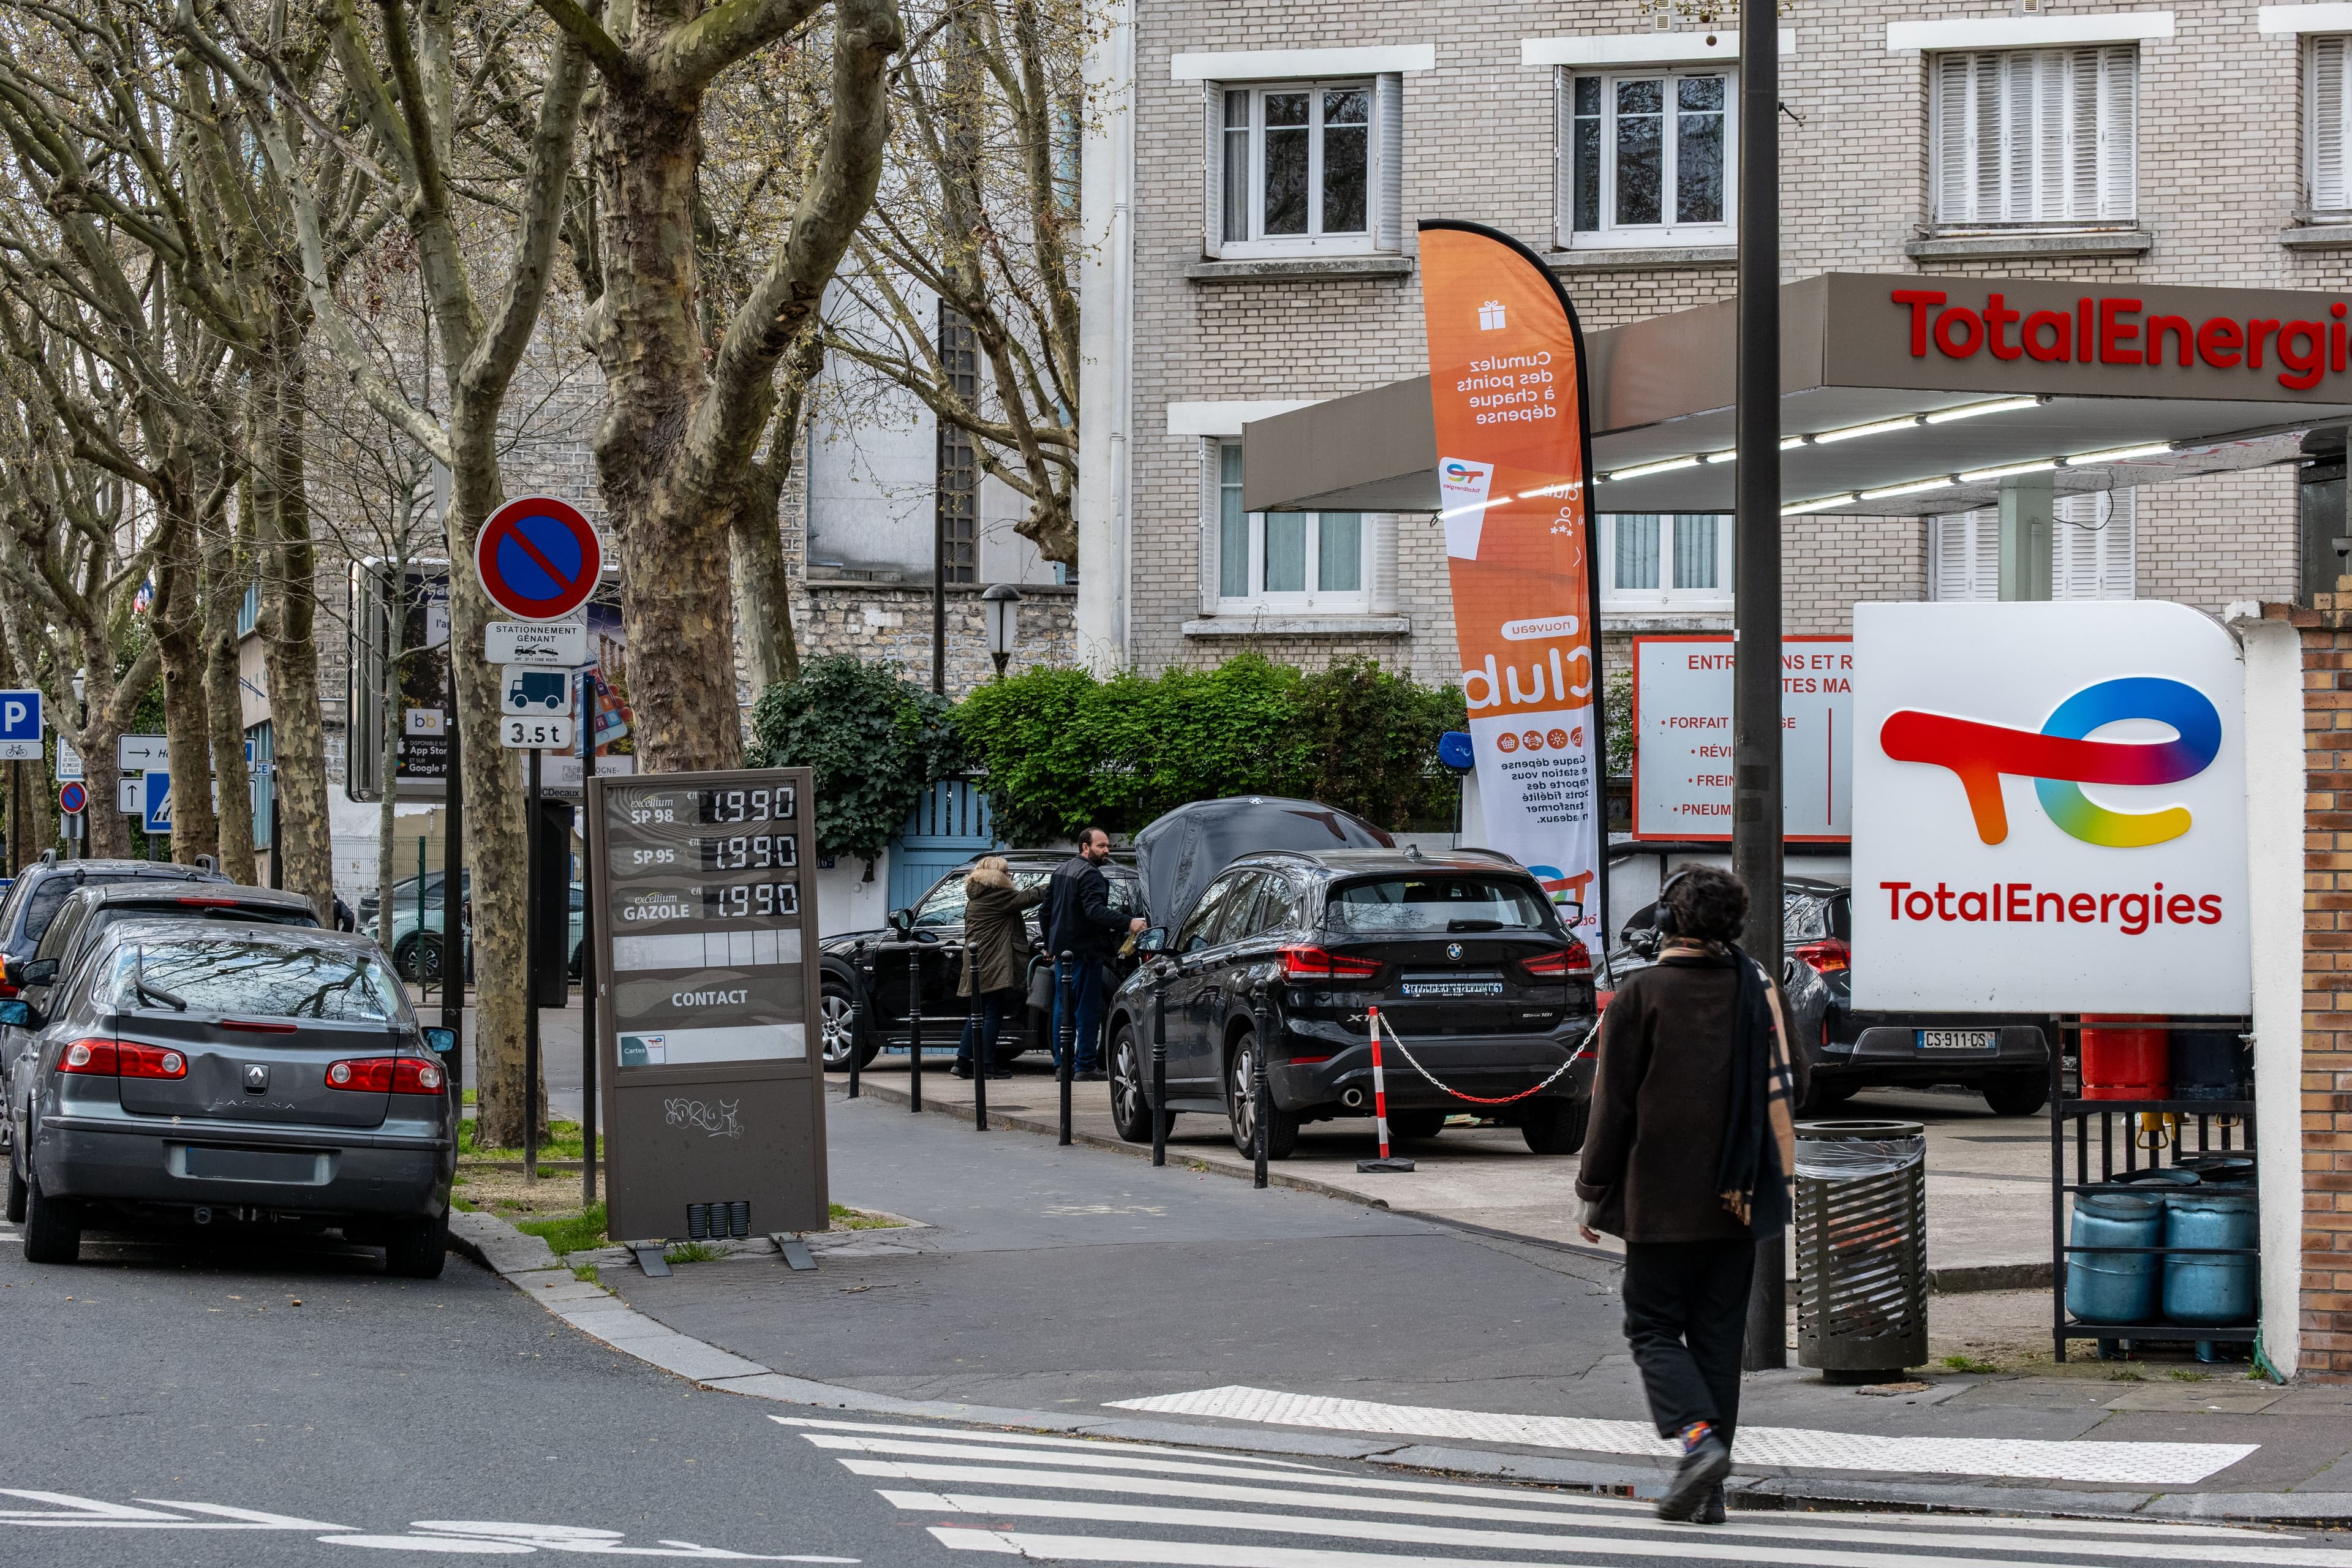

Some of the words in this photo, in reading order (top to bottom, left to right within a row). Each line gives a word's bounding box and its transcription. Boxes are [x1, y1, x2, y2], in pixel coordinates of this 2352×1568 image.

[1892, 289, 2352, 390] TotalEnergi
[496, 625, 577, 634] STATIONNEMENT
[1811, 655, 1834, 669] ET
[5, 701, 26, 732] P
[1670, 717, 1728, 728] FORFAIT
[511, 723, 545, 743] 3.5
[551, 726, 560, 742] t
[410, 747, 428, 756] App
[409, 764, 439, 774] Google
[631, 797, 673, 808] excellium
[714, 787, 794, 821] 1.990
[1682, 804, 1734, 815] PNEUM
[631, 810, 651, 824] SP
[655, 809, 674, 823] 98
[633, 850, 653, 864] SP
[656, 849, 674, 863] 95
[717, 836, 796, 869] 1.990
[635, 893, 677, 904] excellium
[718, 884, 799, 917] 1.990
[624, 904, 690, 920] GAZOLE
[1880, 881, 2223, 935] TotalEnergies
[672, 990, 748, 1006] CONTACT
[215, 1098, 296, 1109] LAGUNA
